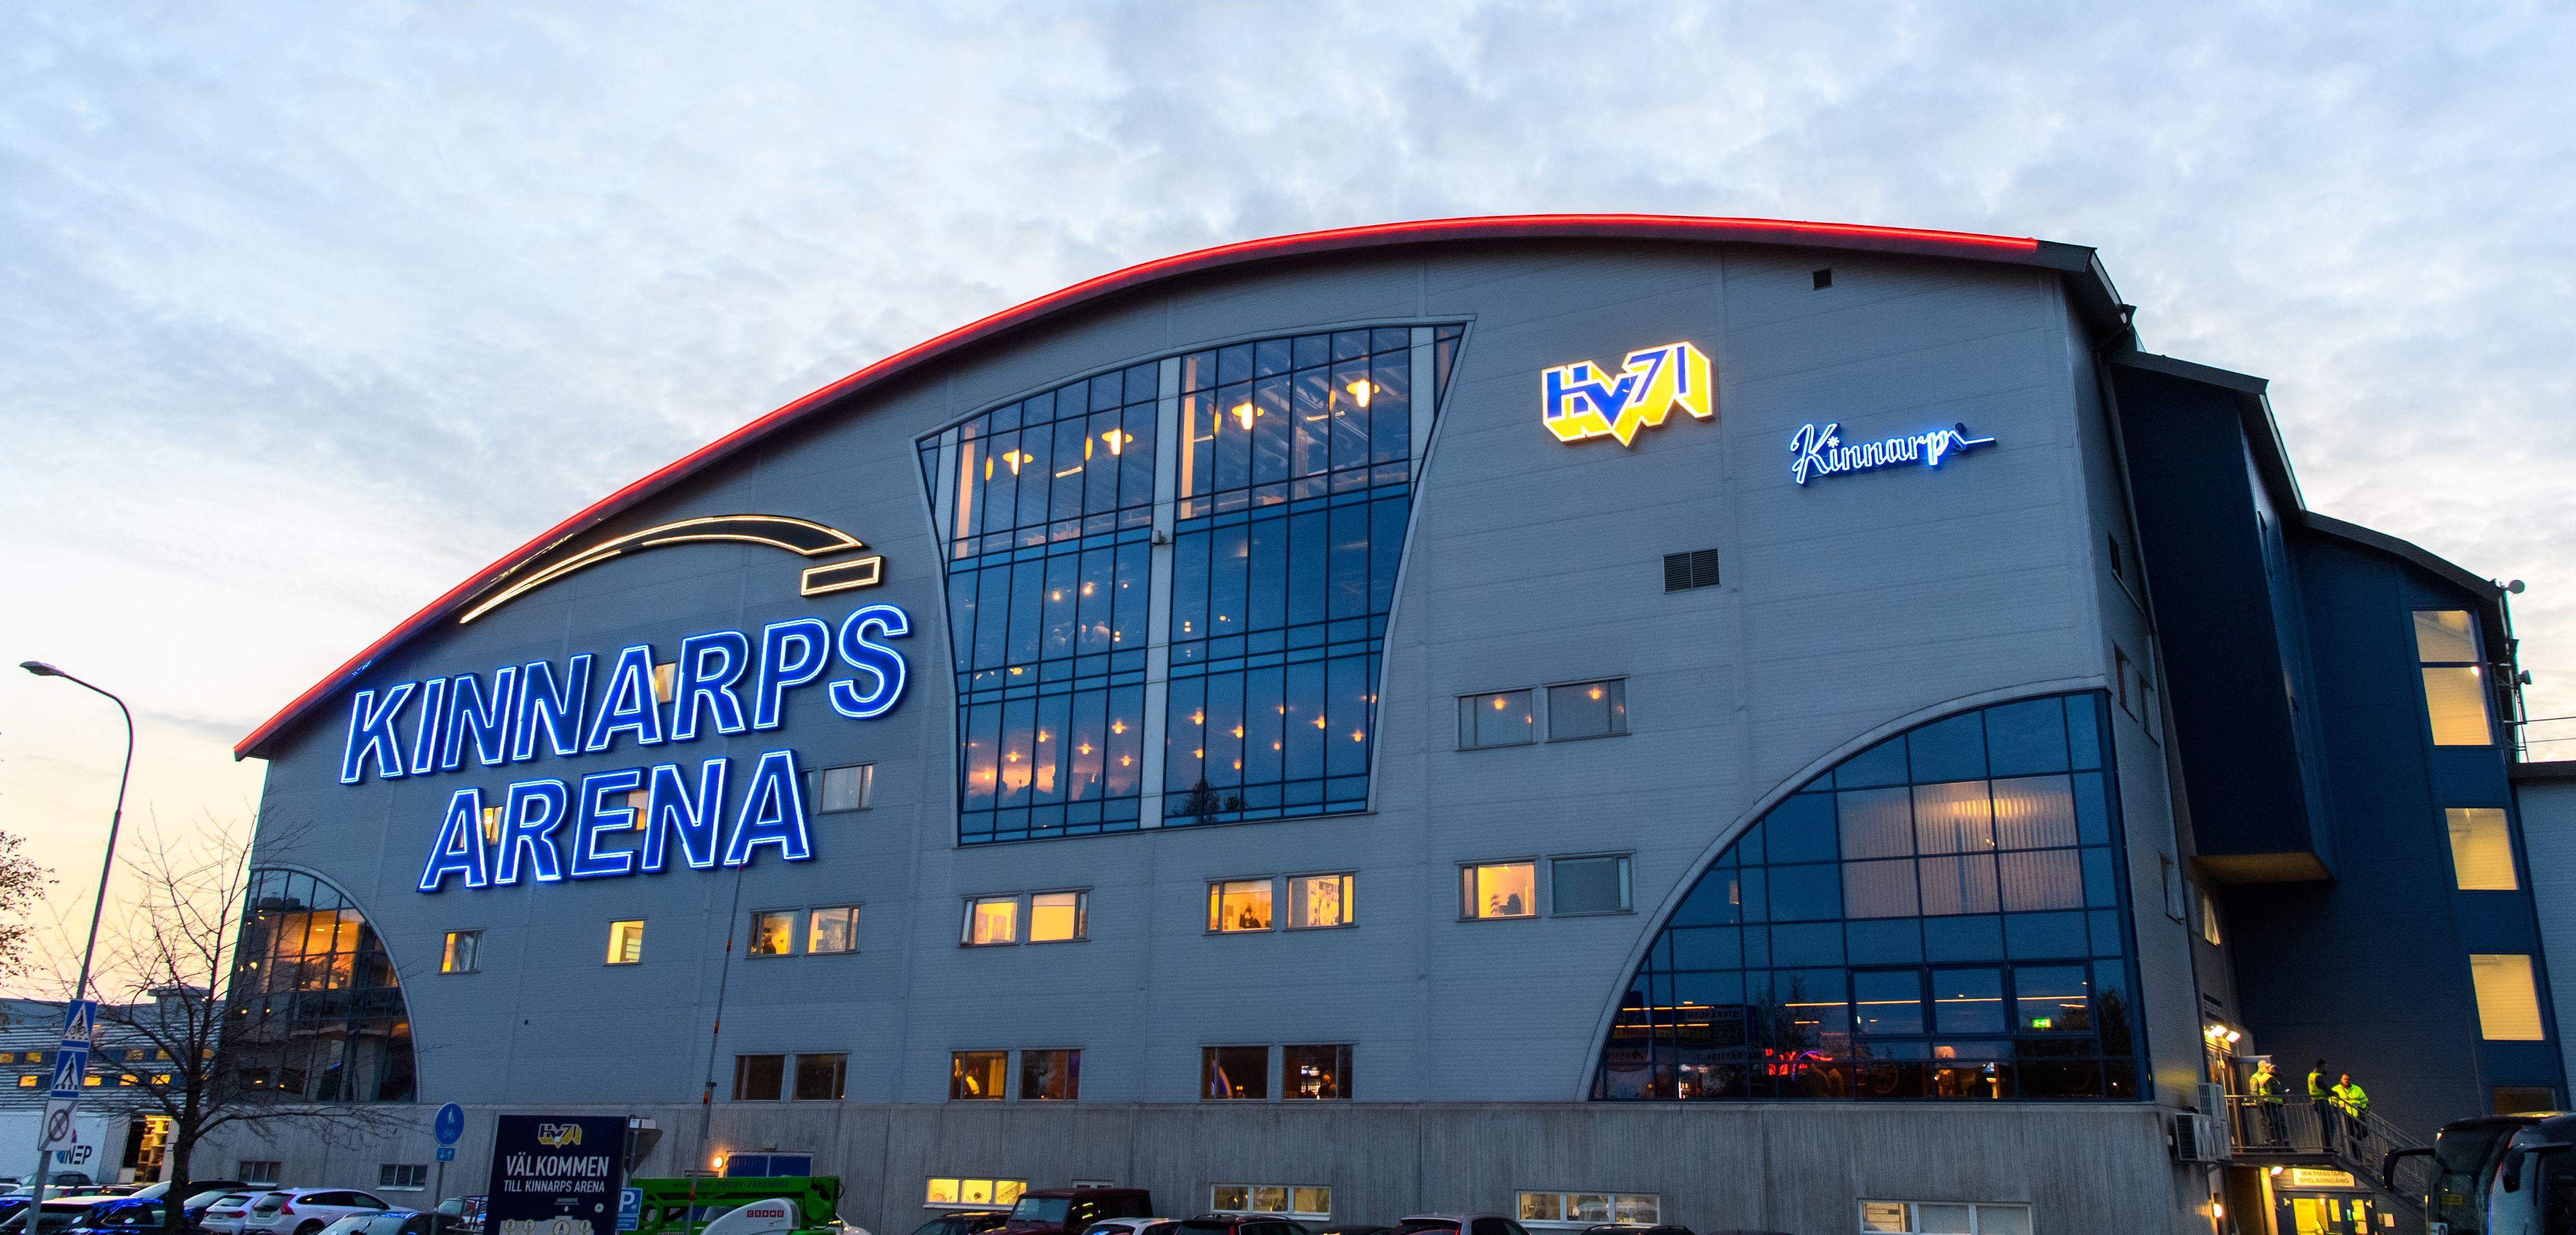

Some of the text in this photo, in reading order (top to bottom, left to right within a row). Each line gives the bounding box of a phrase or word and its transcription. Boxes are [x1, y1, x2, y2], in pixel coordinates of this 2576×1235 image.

[1544, 342, 1706, 439] HV71
[339, 603, 909, 785] KINNARPS
[417, 749, 812, 892] ARENA
[538, 1123, 581, 1146] HV71
[64, 1145, 92, 1164] NEP
[506, 1151, 610, 1177] VÄLKOMMEN
[504, 1179, 605, 1193] TILL KINNARPS ARENA
[618, 1191, 635, 1212] P
